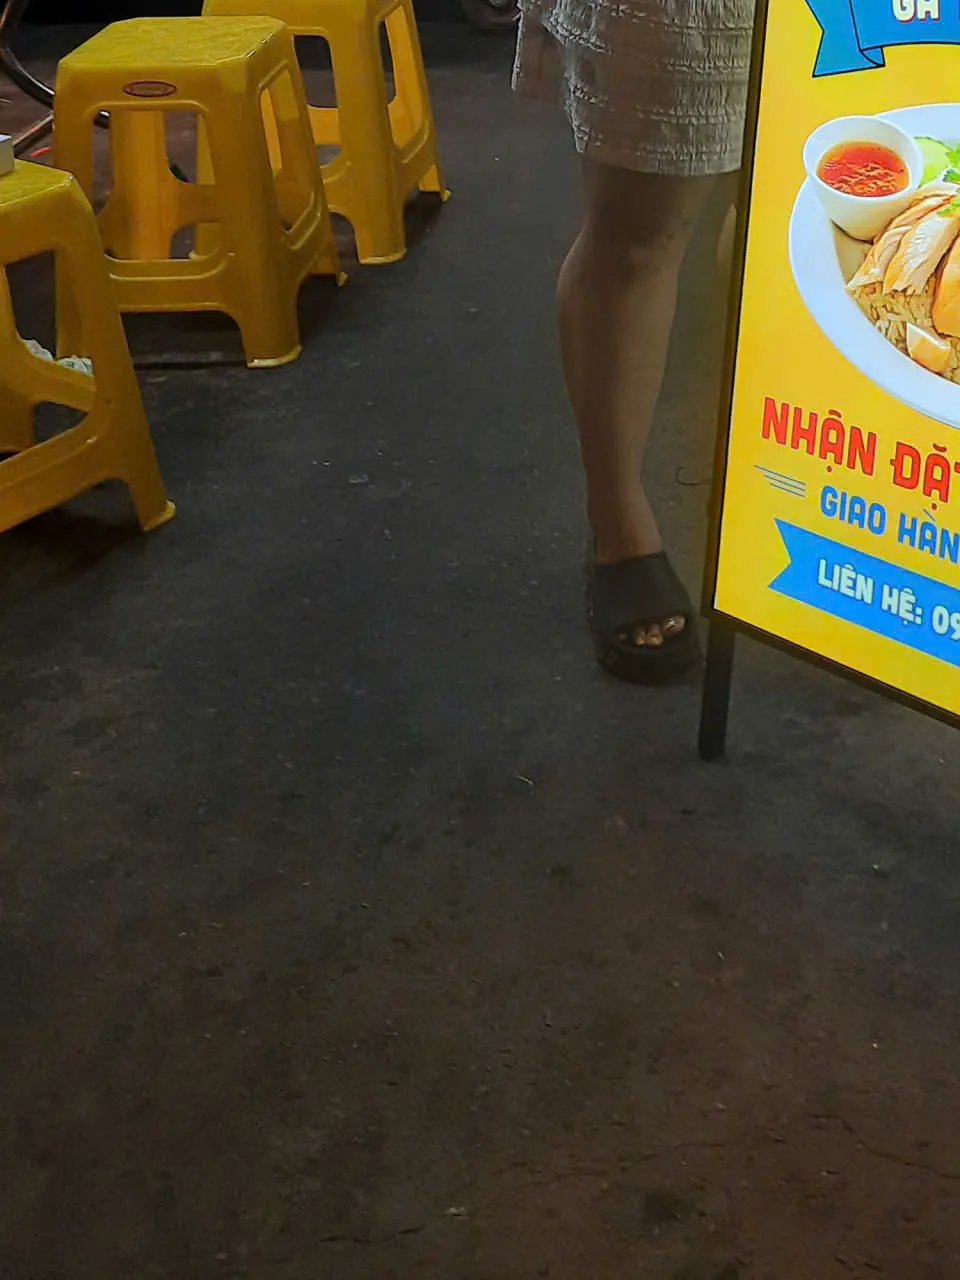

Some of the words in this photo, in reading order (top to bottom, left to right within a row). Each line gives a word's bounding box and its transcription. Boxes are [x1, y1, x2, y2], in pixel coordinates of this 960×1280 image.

[761, 397, 877, 474] NHẬN
[819, 484, 887, 536] GIAO
[816, 558, 874, 607] LIÊN
[881, 582, 924, 627] HỆ:
